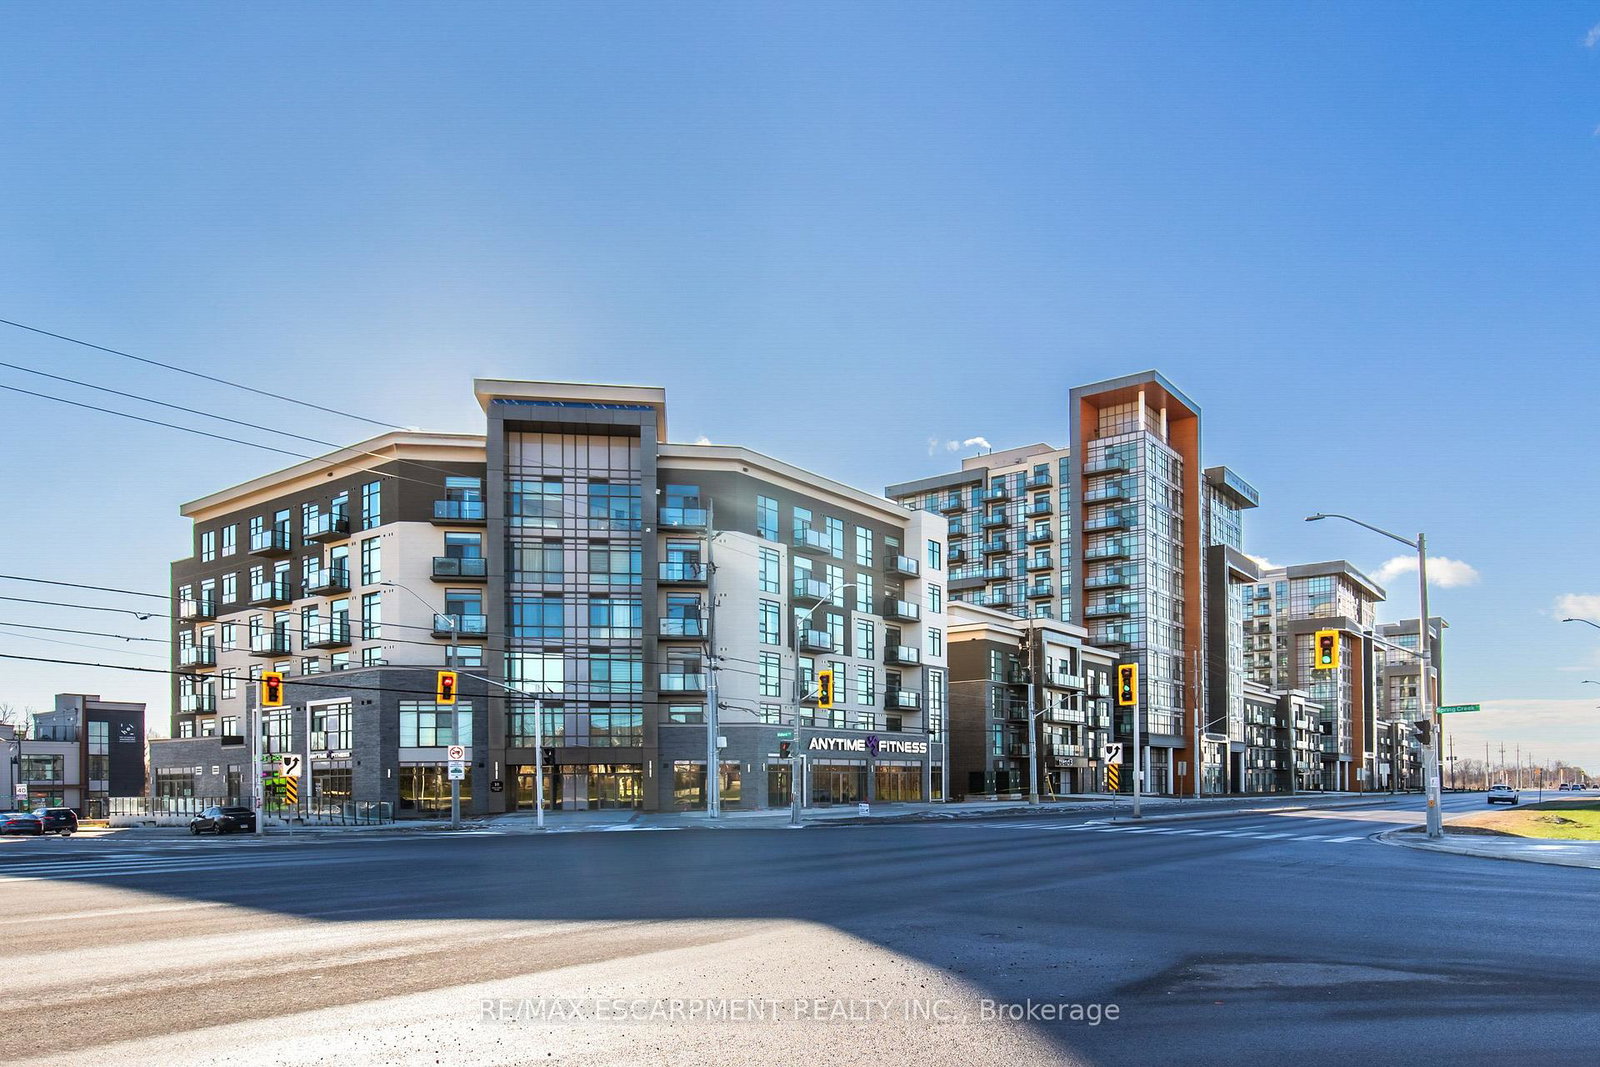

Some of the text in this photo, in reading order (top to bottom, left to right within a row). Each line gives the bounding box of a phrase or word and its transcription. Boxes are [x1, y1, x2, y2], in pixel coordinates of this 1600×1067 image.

[1436, 706, 1456, 714] Spring
[809, 737, 927, 754] ANYTIME FITNESS
